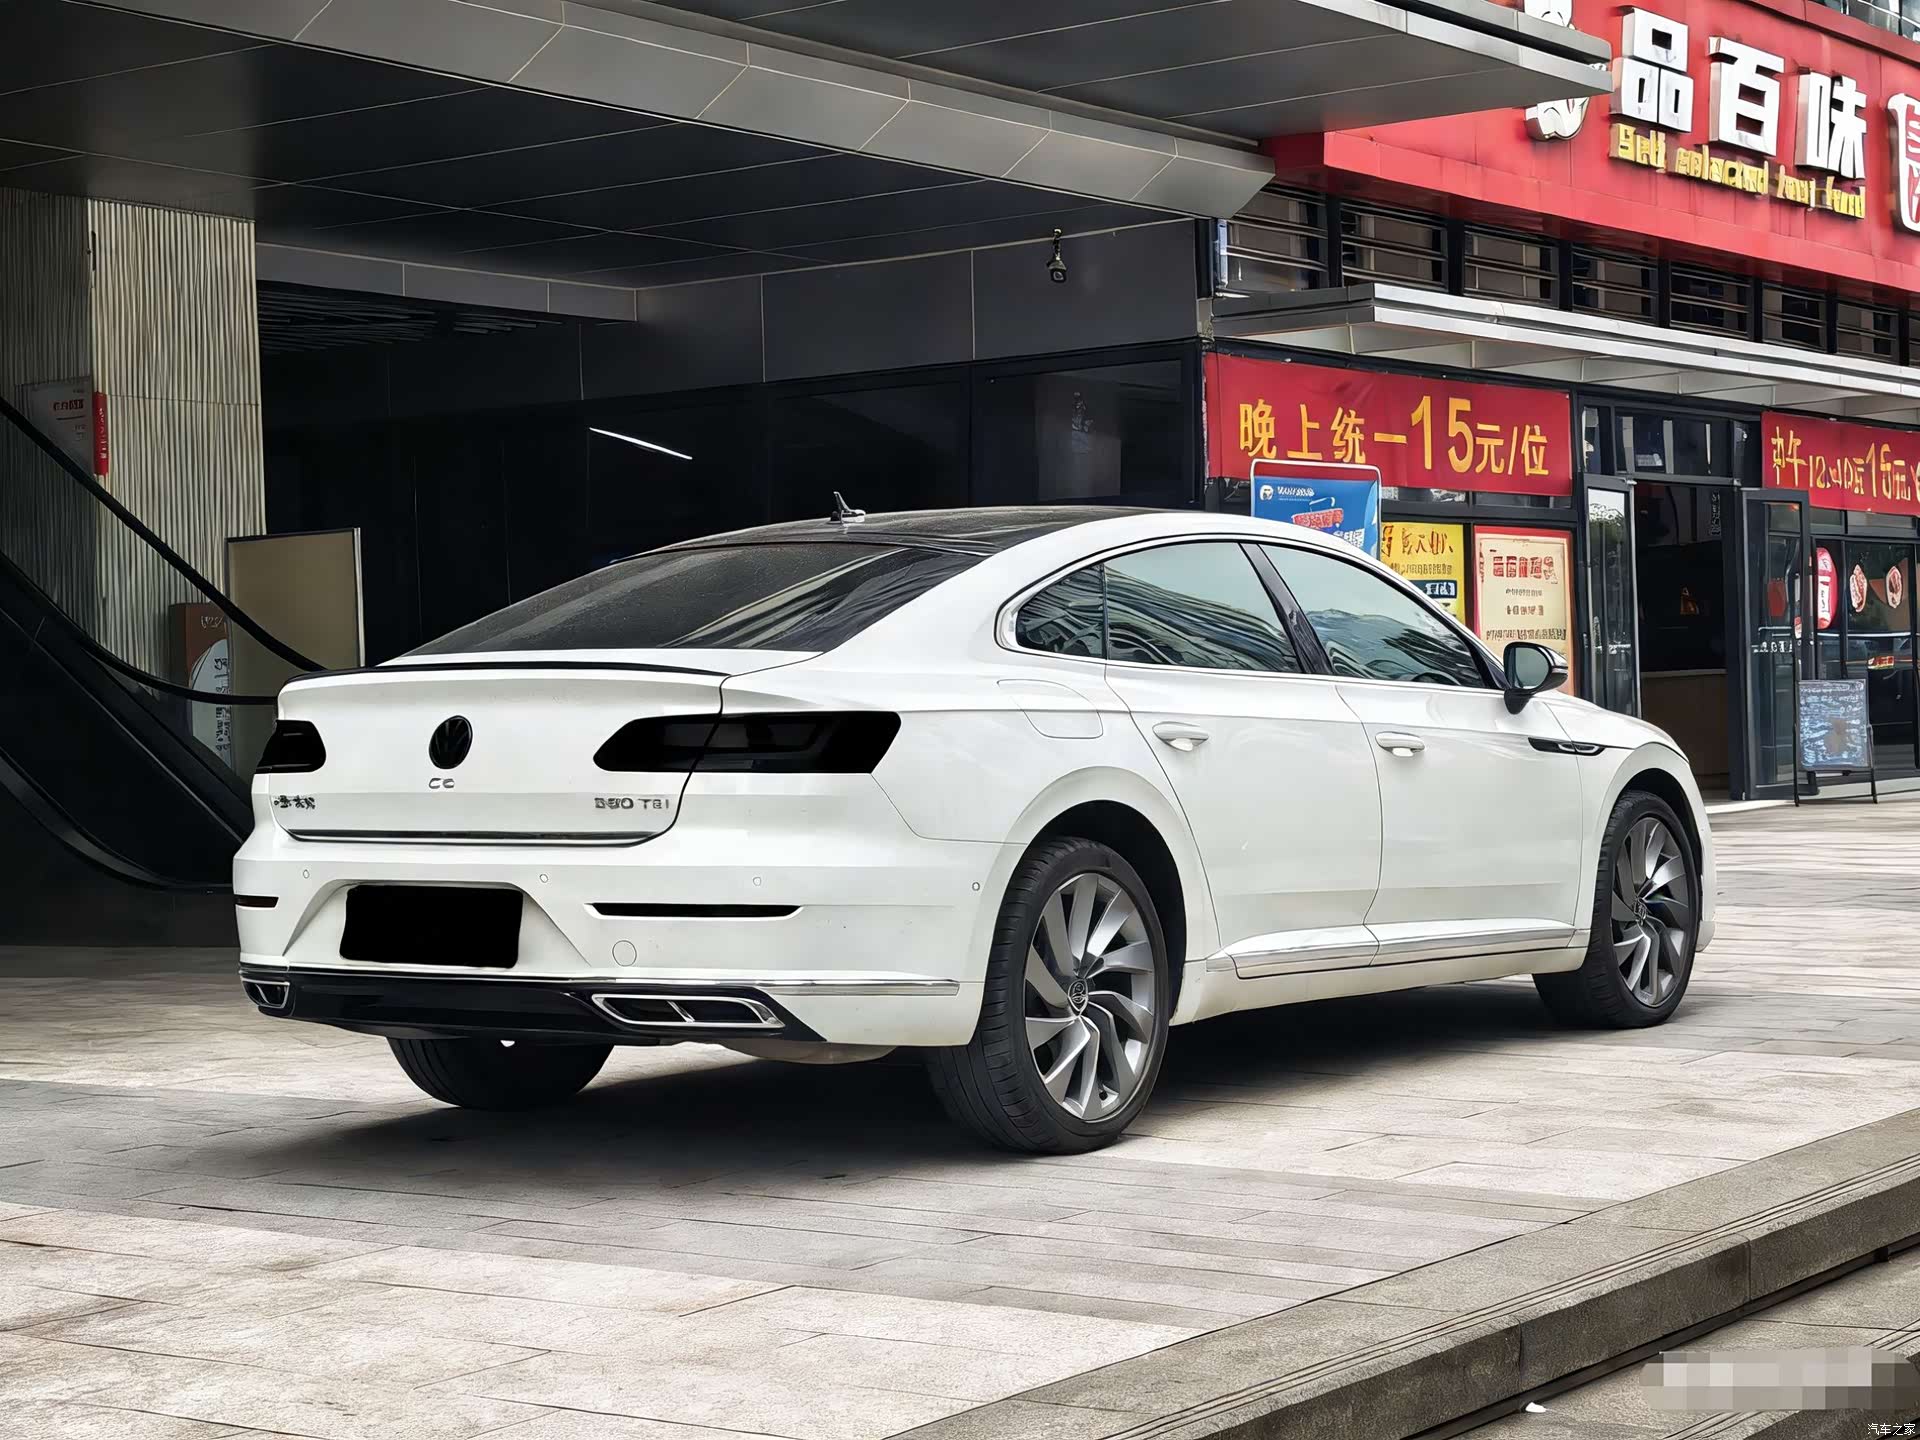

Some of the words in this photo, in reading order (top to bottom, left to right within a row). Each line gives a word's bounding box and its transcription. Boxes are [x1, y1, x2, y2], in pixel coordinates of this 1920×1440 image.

[1612, 7, 1867, 180] 品百味
[1239, 394, 1550, 477] 晚上统一15元/位
